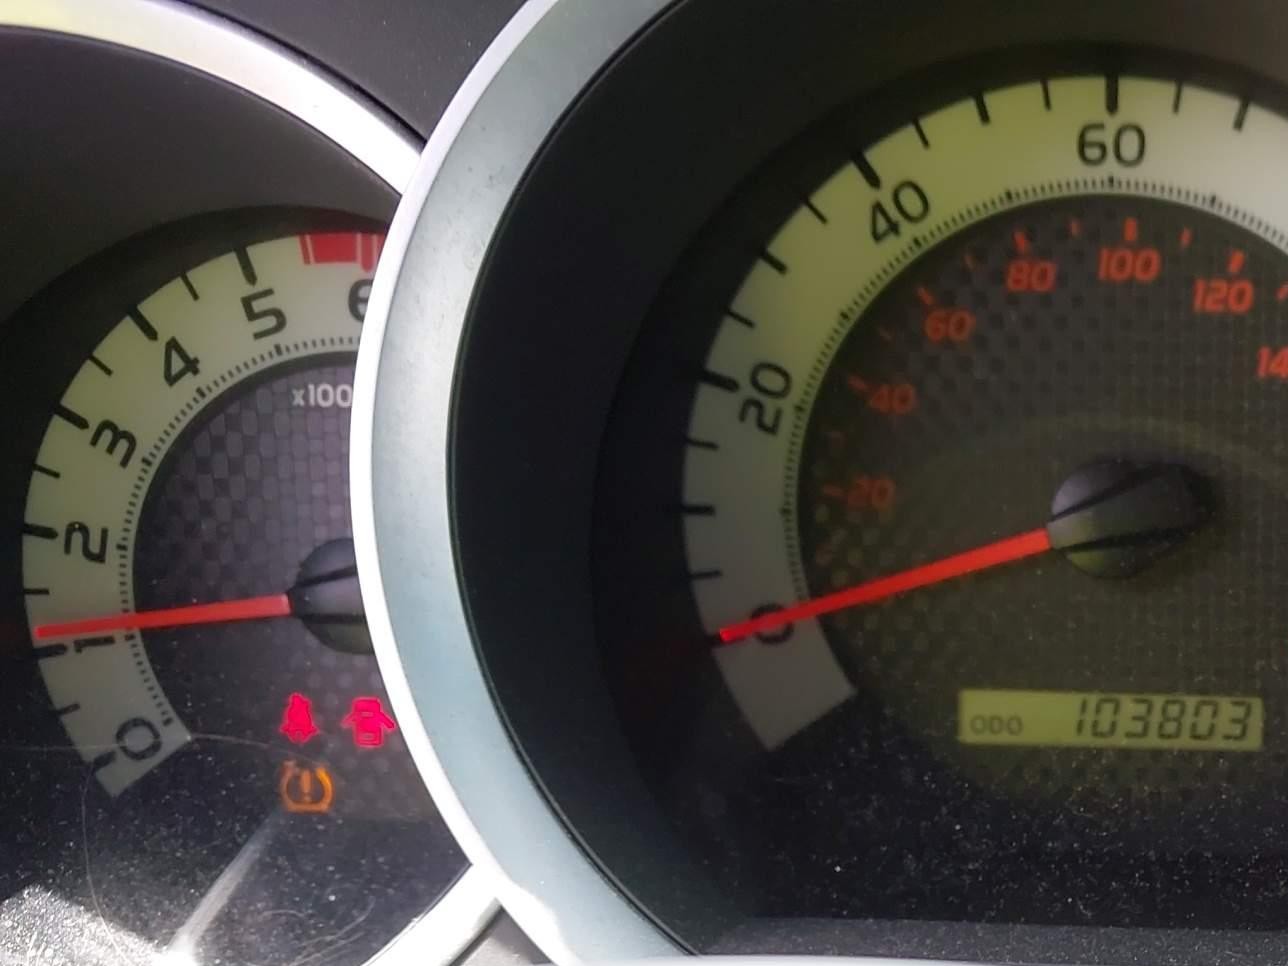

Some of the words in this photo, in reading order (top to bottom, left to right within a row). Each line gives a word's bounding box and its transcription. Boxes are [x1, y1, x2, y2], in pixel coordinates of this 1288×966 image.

[1077, 123, 1146, 167] 60
[869, 180, 930, 243] 40
[1006, 261, 1056, 292] 80
[1099, 248, 1161, 282] 100
[240, 288, 288, 339] 5
[1193, 279, 1254, 313] 120
[925, 311, 976, 343] 60
[162, 336, 200, 387] 4
[739, 362, 793, 436] 20
[867, 384, 916, 414] 40
[89, 419, 138, 467] 3
[64, 521, 109, 564] 2
[73, 635, 115, 654] 1
[115, 722, 161, 760] 0
[970, 714, 1024, 736] ODO
[1074, 698, 1252, 741] 103803
